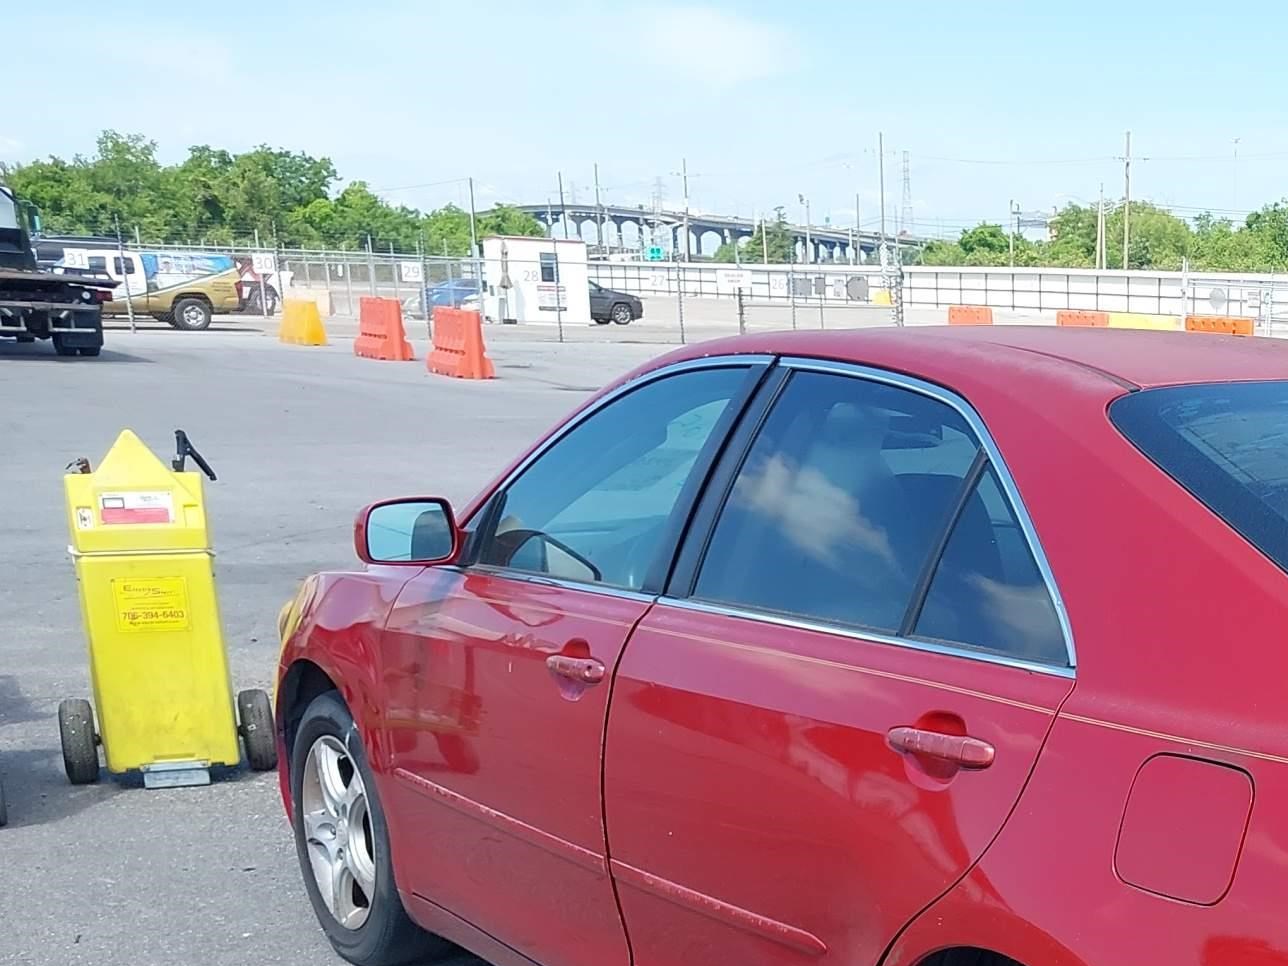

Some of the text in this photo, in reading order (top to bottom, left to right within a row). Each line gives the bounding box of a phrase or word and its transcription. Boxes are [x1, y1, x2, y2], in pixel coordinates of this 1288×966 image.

[67, 253, 85, 266] 31
[255, 257, 272, 269] 30
[404, 265, 420, 278] 29
[523, 269, 539, 282] 28
[650, 274, 665, 287] 27
[771, 278, 785, 290] 26
